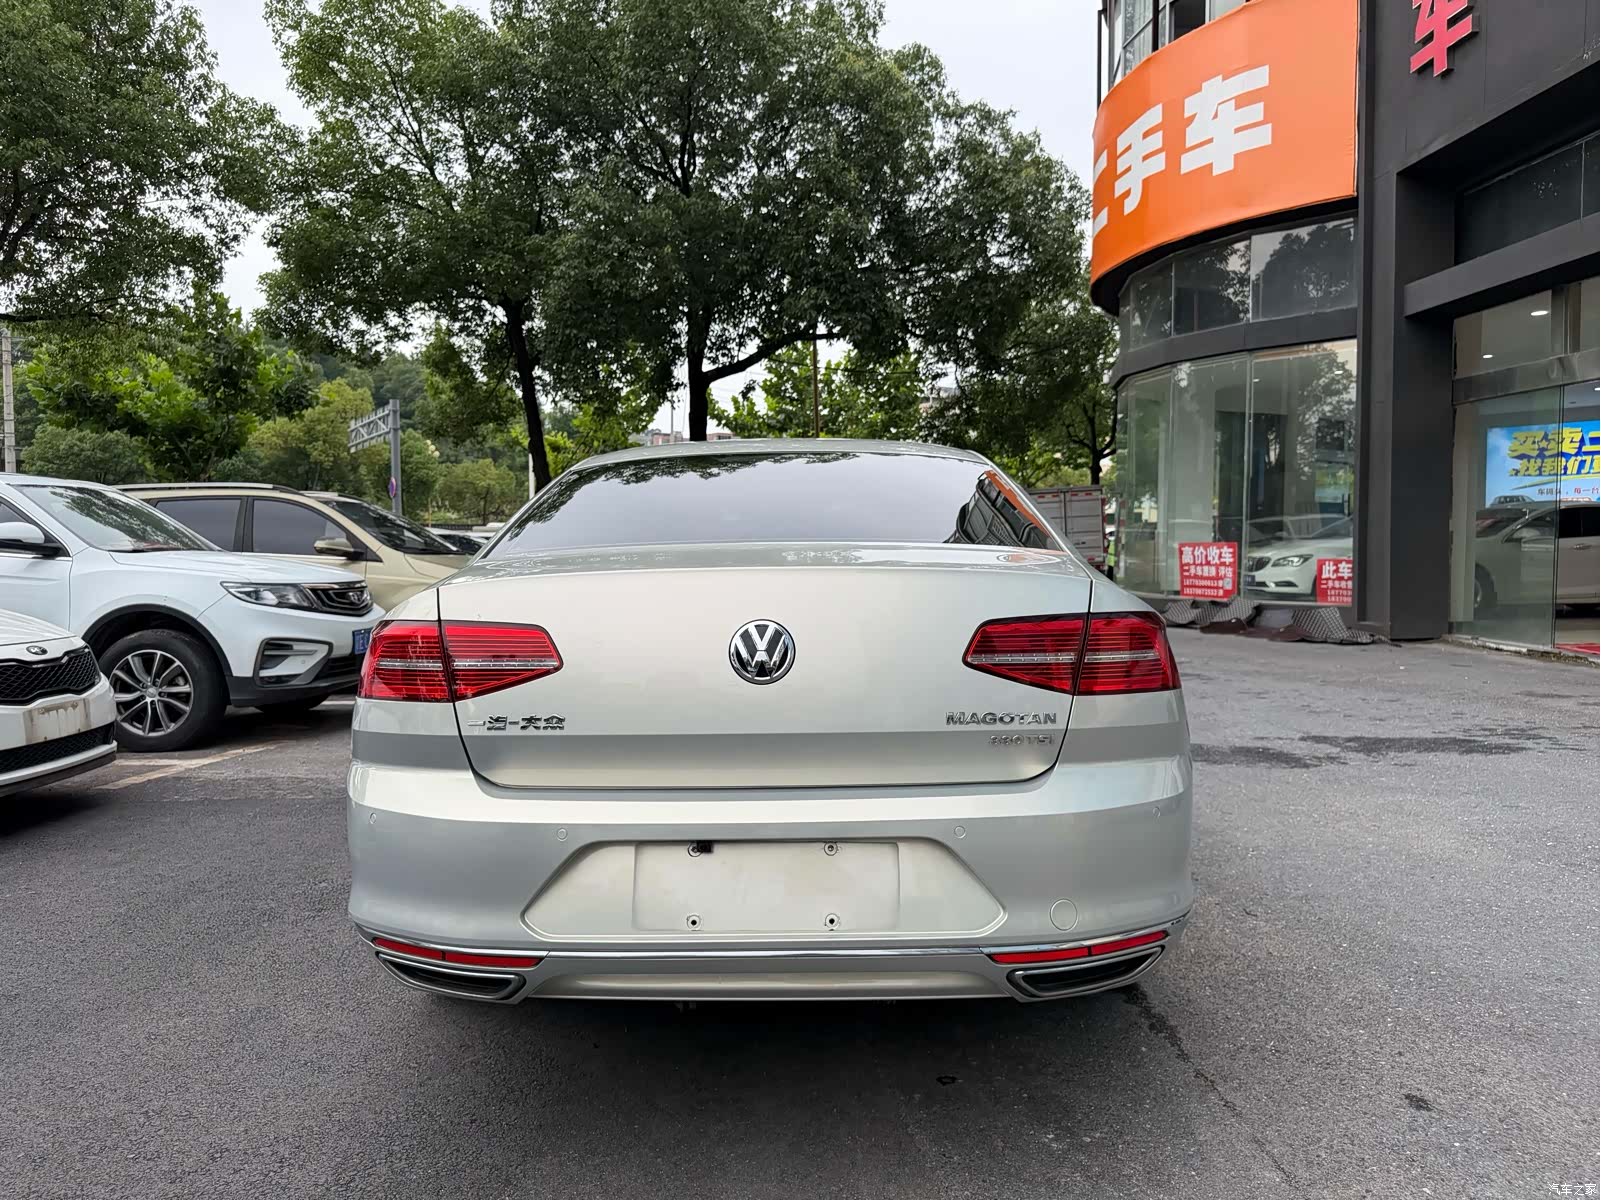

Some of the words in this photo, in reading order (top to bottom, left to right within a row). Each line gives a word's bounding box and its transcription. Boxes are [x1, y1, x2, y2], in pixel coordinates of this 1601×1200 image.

[1410, 0, 1473, 77] 车
[1181, 546, 1234, 565] 高价收车
[945, 711, 1057, 726] MAGOTAN
